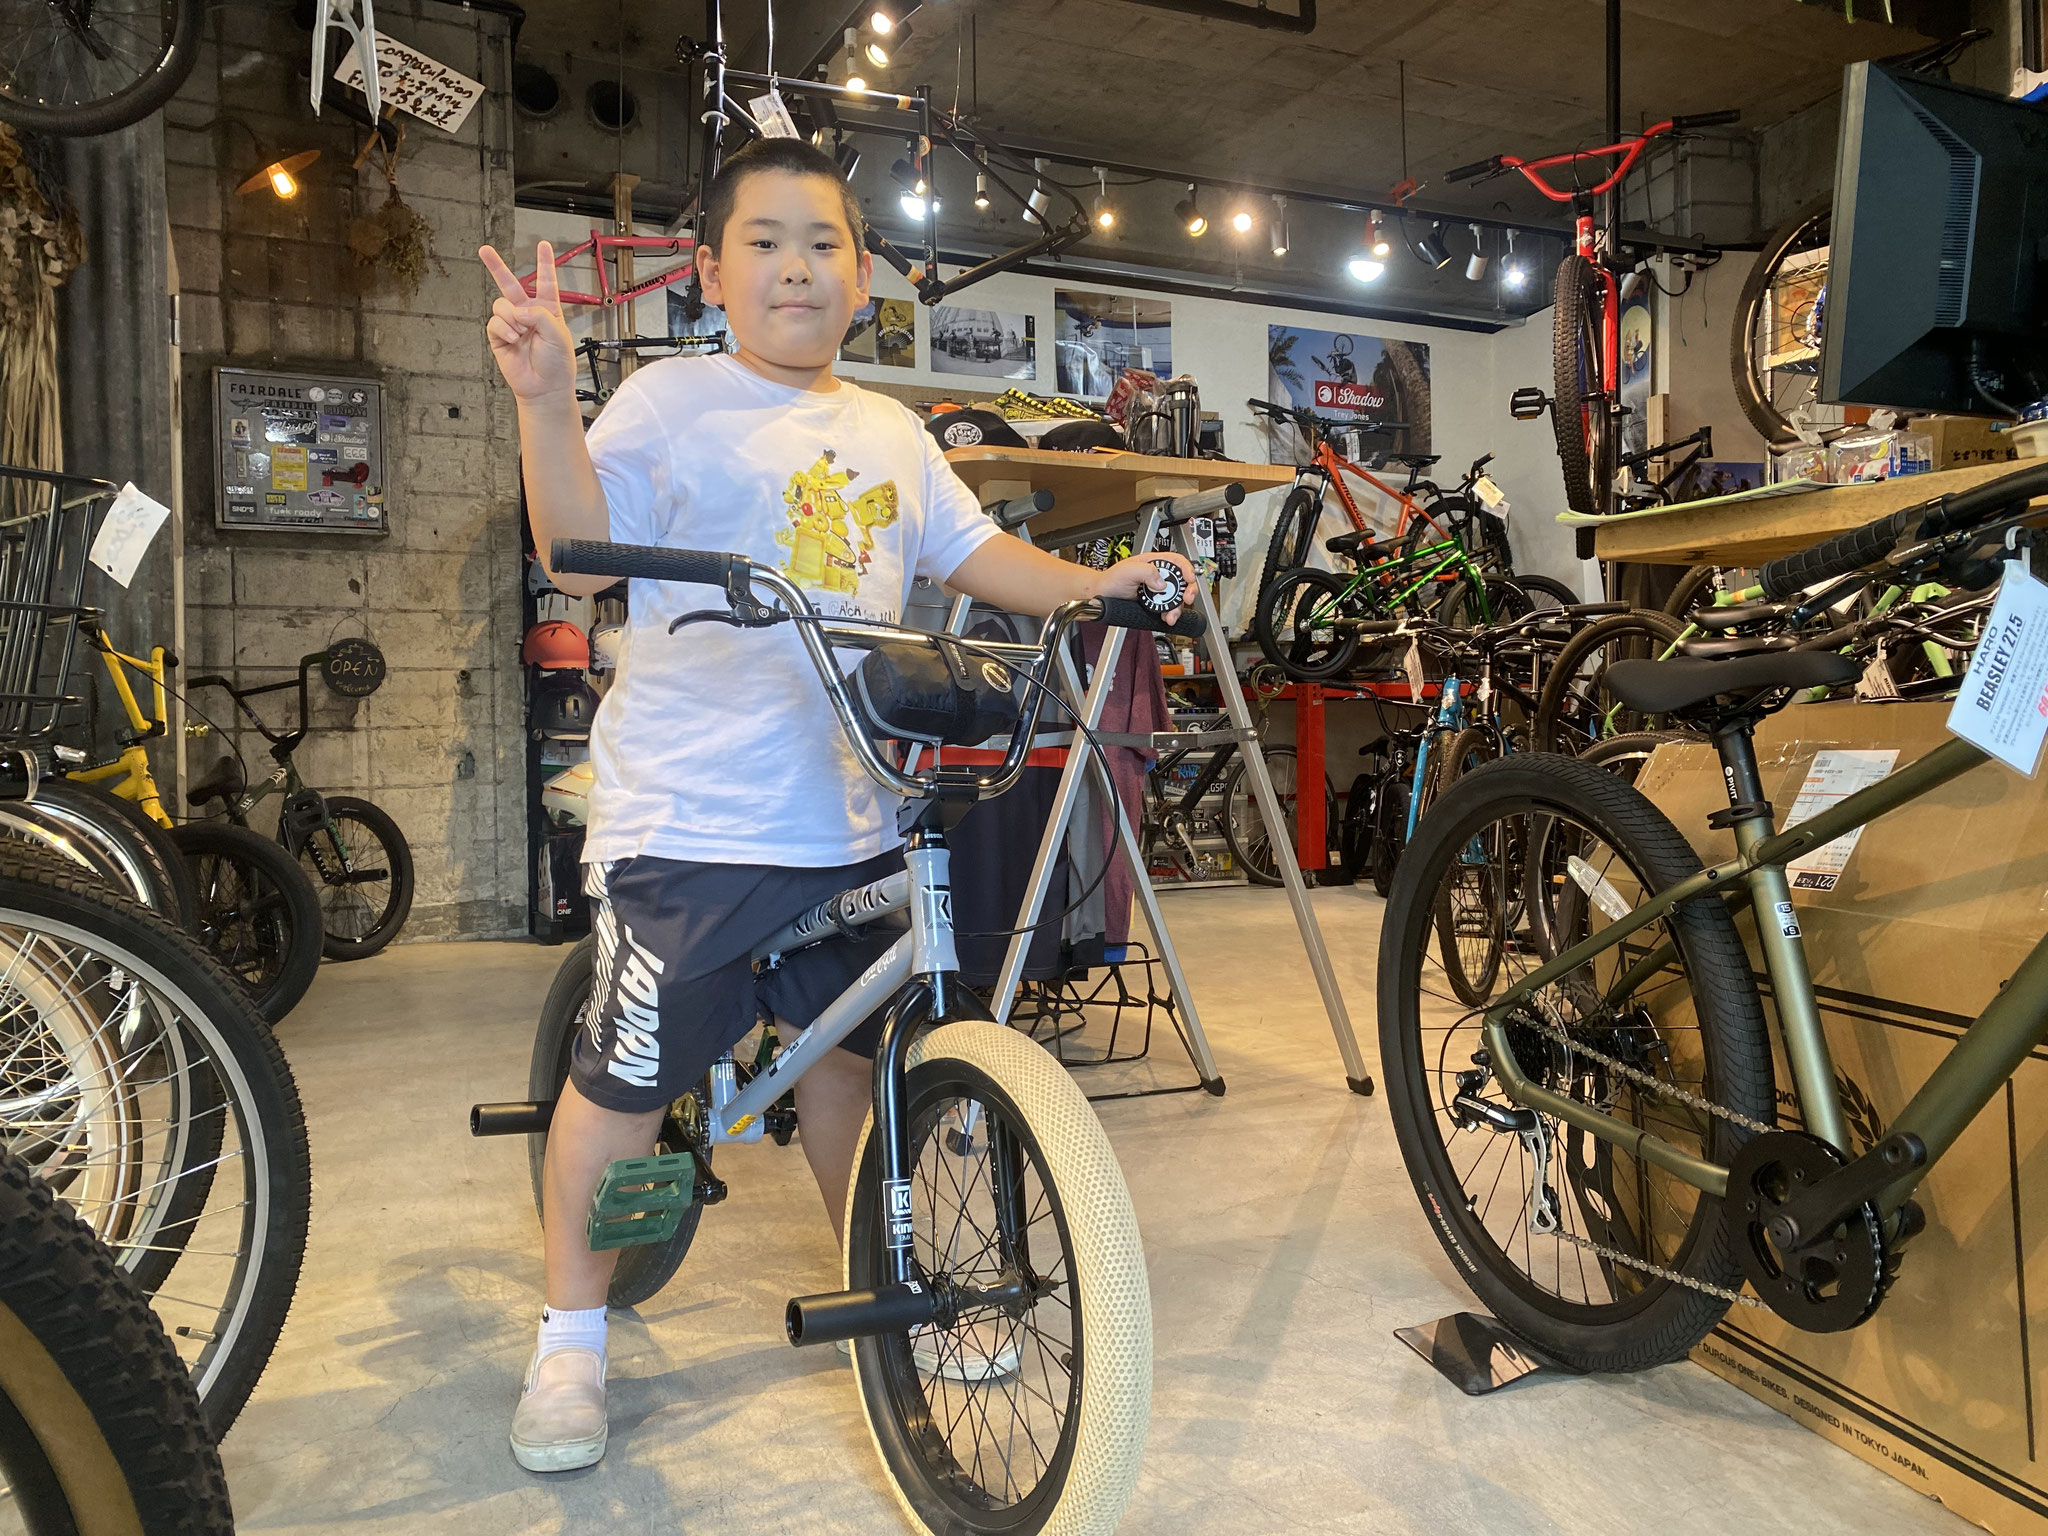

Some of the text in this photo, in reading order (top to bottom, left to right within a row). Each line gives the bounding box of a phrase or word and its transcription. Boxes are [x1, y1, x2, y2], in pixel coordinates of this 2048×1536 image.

[230, 383, 302, 399] FAIRDALE
[1337, 387, 1384, 408] Shadow
[1334, 409, 1370, 421] Trey Jones
[1158, 537, 1171, 548] FIST
[1197, 540, 1213, 548] FIST
[1144, 600, 1170, 611] BIKES
[1973, 626, 1999, 675] HARO
[330, 659, 378, 677] OPEN
[1976, 645, 2011, 712] BEASLEY
[2002, 613, 2024, 648] 27.5
[541, 750, 570, 763] ern
[1726, 776, 1738, 800] PIVIT
[1814, 875, 1837, 888] 221
[1780, 903, 1792, 913] 15
[607, 924, 665, 1087] JAPAN
[1703, 1344, 1737, 1370] DURCUS
[1793, 1394, 1841, 1428] DESIGNED
[1842, 1421, 1853, 1437] IN
[1853, 1428, 1889, 1457] TOKYO
[1891, 1451, 1930, 1480] JAPAN.
